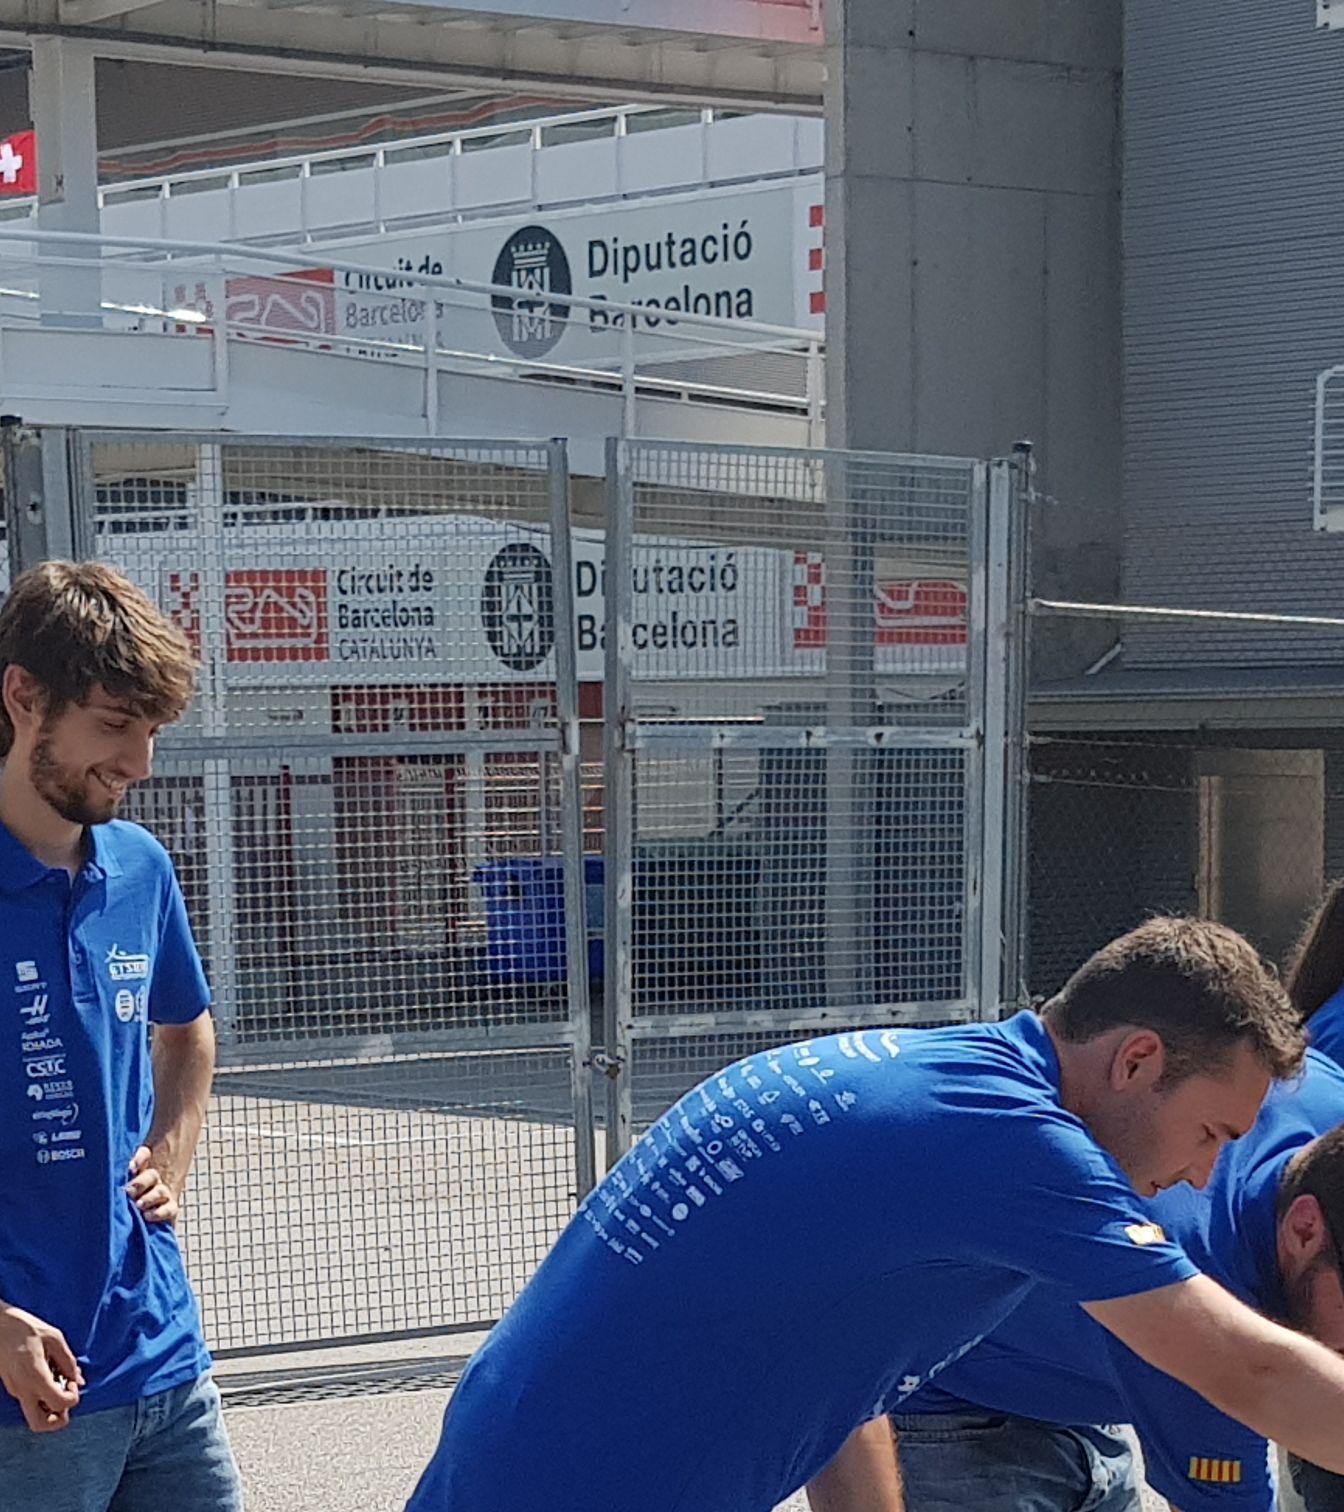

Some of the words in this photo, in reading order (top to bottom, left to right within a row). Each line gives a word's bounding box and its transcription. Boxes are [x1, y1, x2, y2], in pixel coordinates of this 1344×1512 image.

[588, 219, 753, 283] Diputació
[337, 564, 404, 596] Circuit
[407, 563, 434, 593] de
[576, 553, 739, 597] Diutació
[338, 600, 435, 629] Barcelona
[577, 611, 739, 651] Bacelona
[339, 637, 436, 661] CATALUNYA
